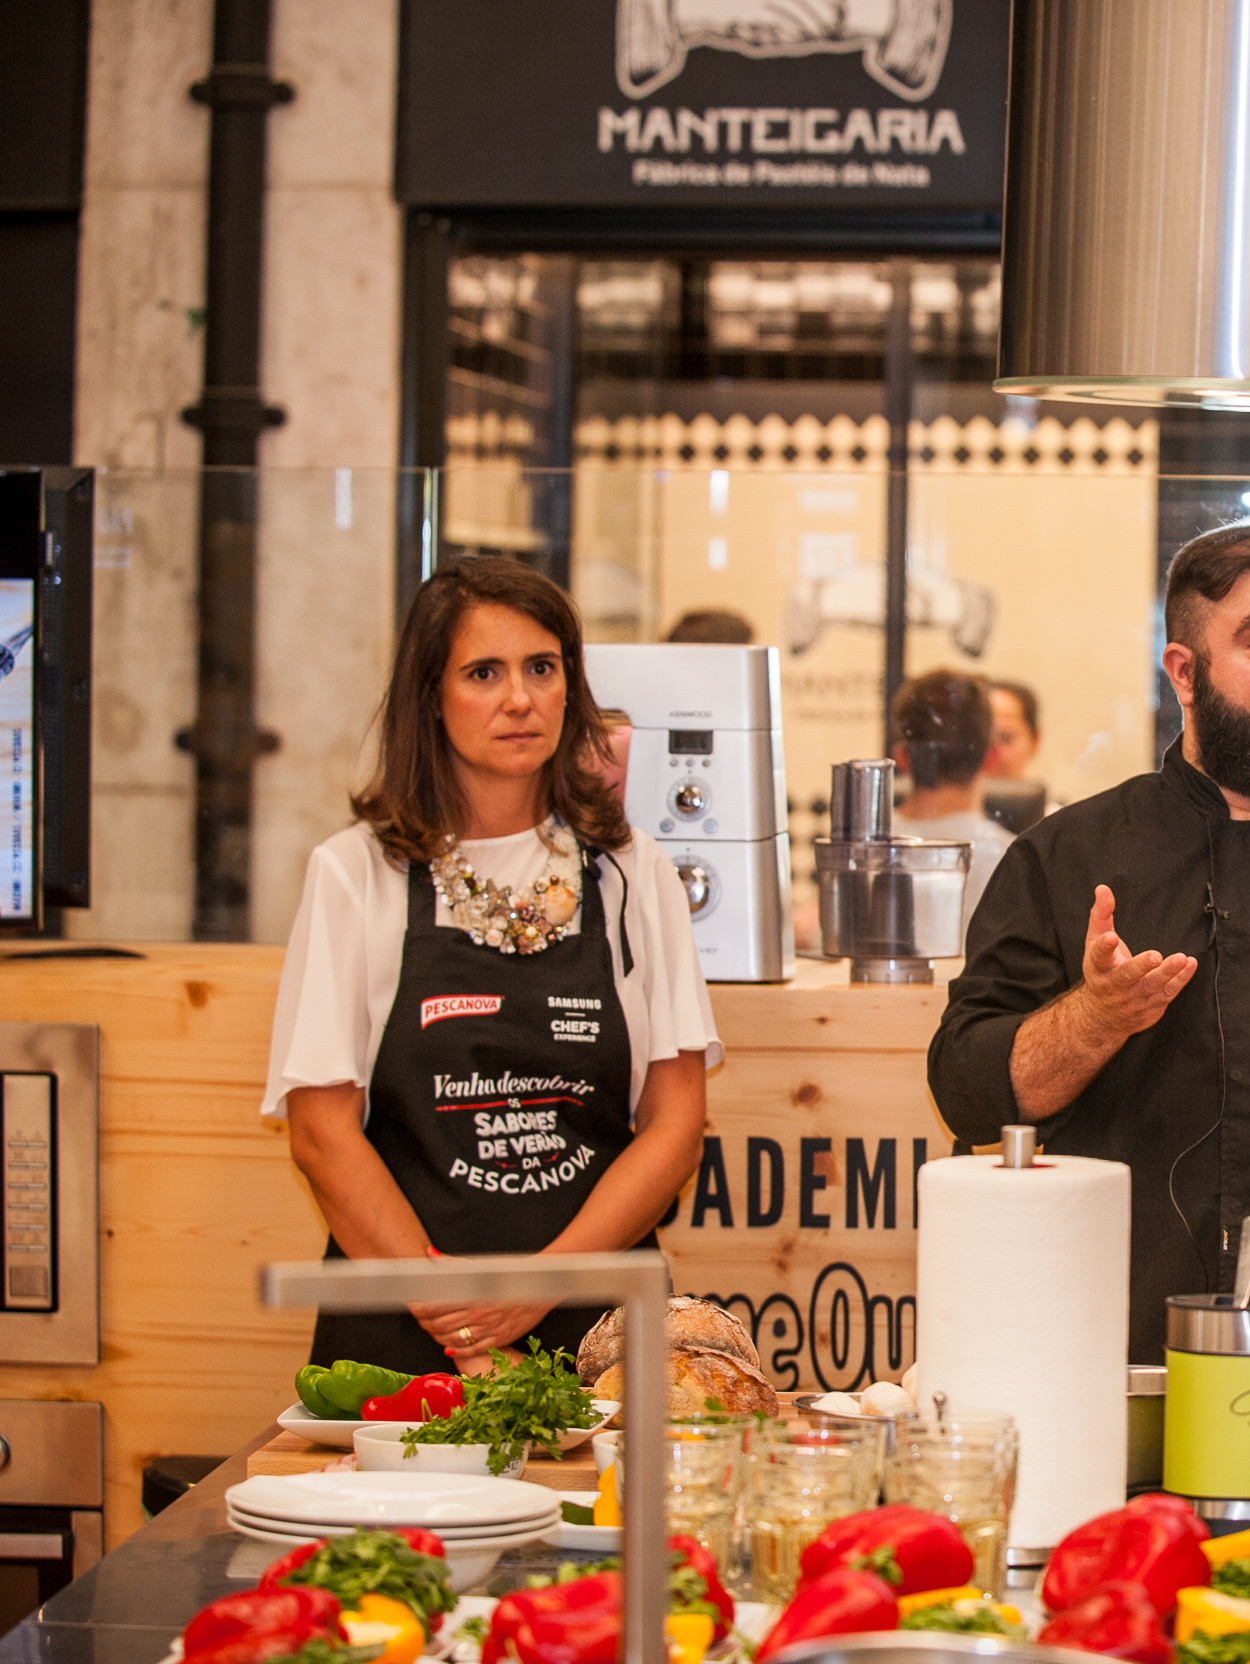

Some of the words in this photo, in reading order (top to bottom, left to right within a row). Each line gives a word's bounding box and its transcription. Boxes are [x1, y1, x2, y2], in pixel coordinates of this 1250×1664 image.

[597, 106, 966, 154] MANTEIGARIA
[424, 999, 498, 1018] PESCANOVA
[547, 996, 602, 1010] SAMSUNG
[550, 1020, 600, 1034] CHEF'S
[434, 1072, 496, 1099] Venha
[497, 1071, 595, 1096] descobrir
[474, 1111, 558, 1137] SABORES
[477, 1140, 509, 1160] DE
[449, 1144, 596, 1194] PESCANOVA
[522, 1156, 541, 1169] DA
[658, 1136, 927, 1230] ADEMI
